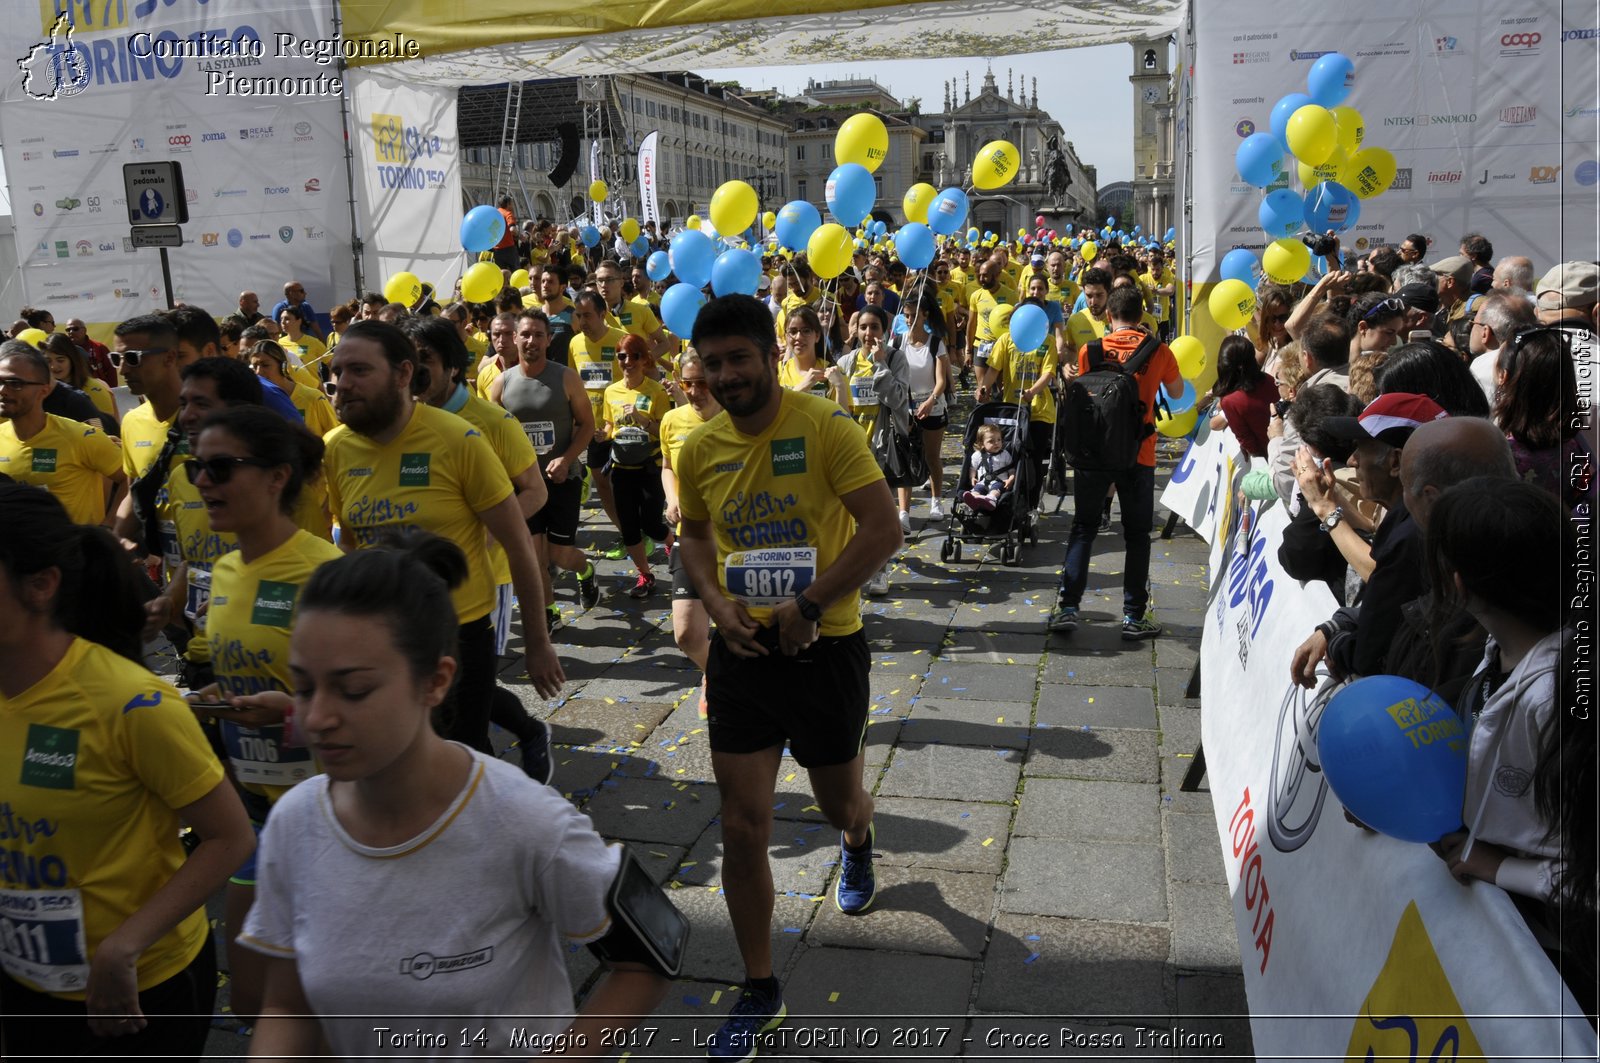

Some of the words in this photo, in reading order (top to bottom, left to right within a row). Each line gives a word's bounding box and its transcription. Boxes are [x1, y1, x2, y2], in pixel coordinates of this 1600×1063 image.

[1500, 32, 1542, 47] coop
[46, 30, 183, 86] TORINO
[197, 61, 213, 72] LA
[214, 57, 262, 69] STAMPA
[1232, 97, 1258, 105] sponsored
[1384, 114, 1415, 126] INTESA
[1499, 106, 1537, 123] LAURETANA
[250, 126, 274, 134] REALE
[168, 135, 192, 146] coop
[990, 156, 1008, 173] TORINO
[133, 177, 165, 186] pedonale
[377, 165, 425, 190] TORINO
[426, 170, 445, 183] 150
[1357, 172, 1376, 193] TORINO
[1428, 170, 1462, 183] inalpi
[1356, 223, 1377, 231] powered
[99, 242, 116, 252] Cuki
[773, 450, 805, 463] Arredo3
[400, 465, 429, 475] Arredo3
[727, 518, 808, 548] TORINO
[793, 551, 812, 559] 150
[744, 568, 796, 597] 9812
[238, 736, 280, 763] 1706
[24, 747, 76, 768] Arredo3
[0, 801, 58, 845] tra
[1228, 786, 1275, 977] TOYOTA
